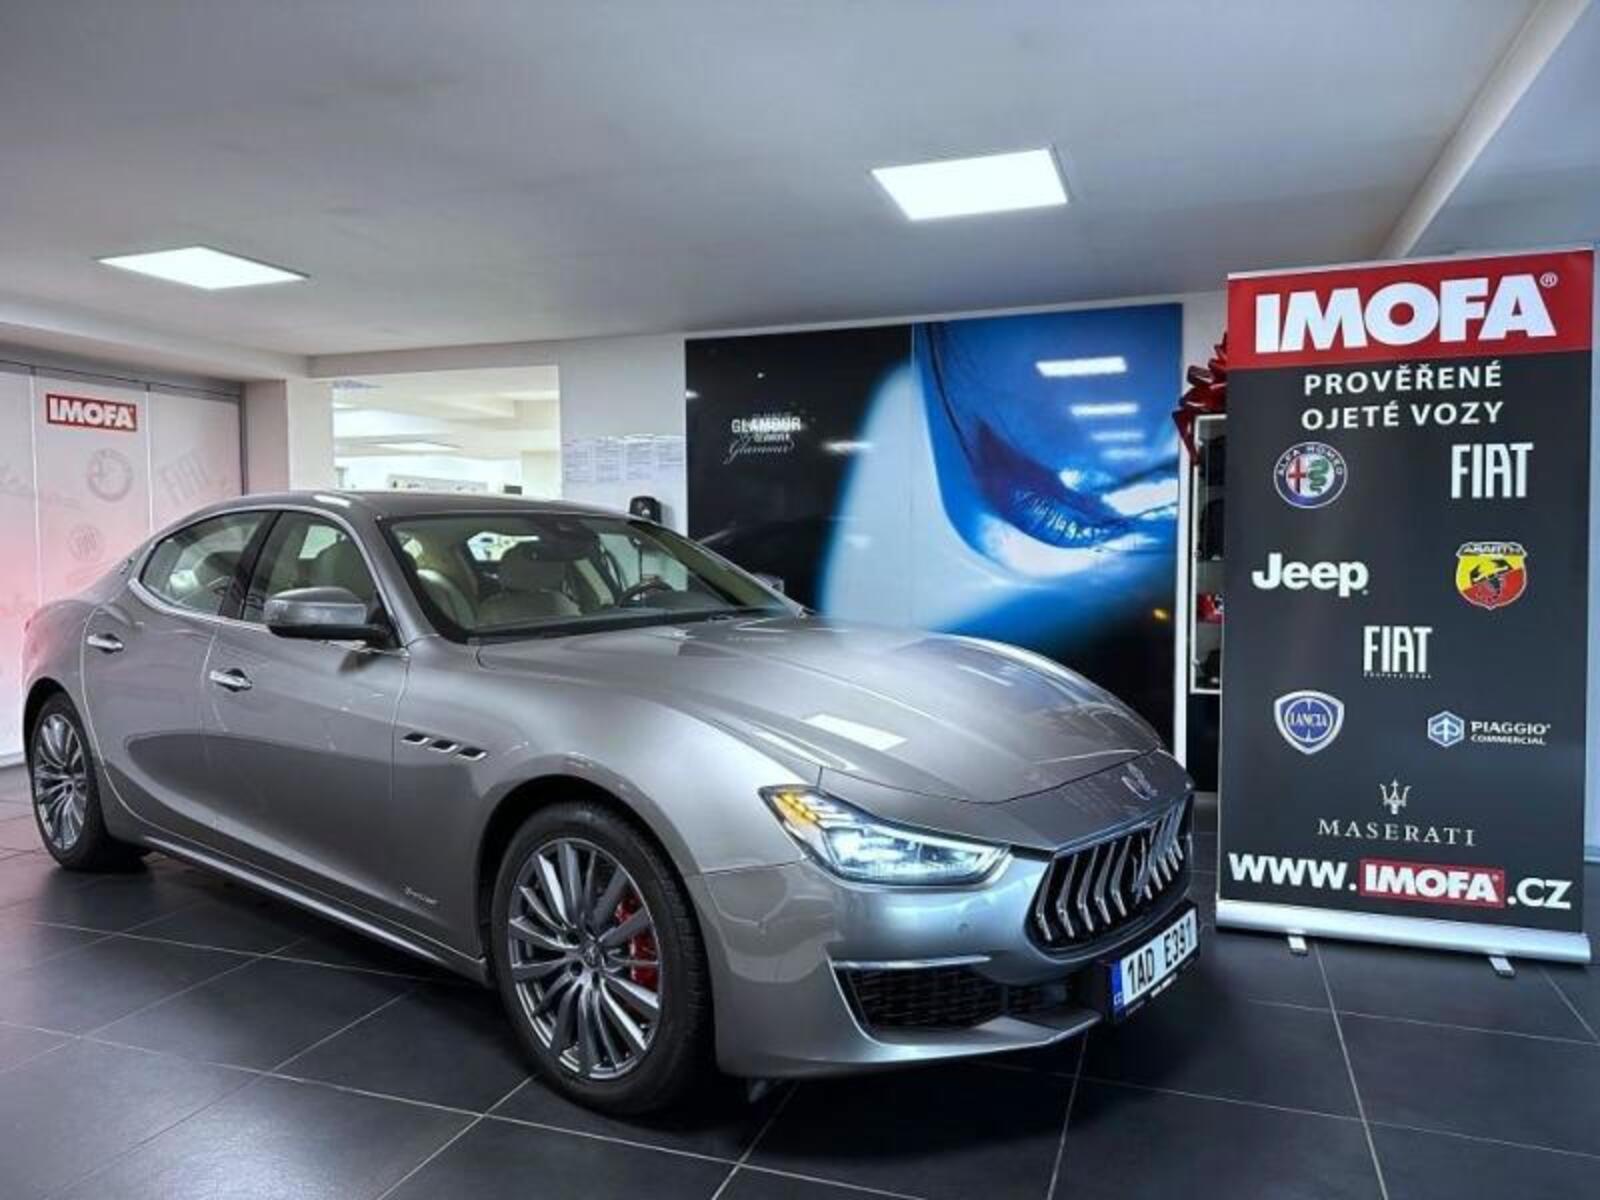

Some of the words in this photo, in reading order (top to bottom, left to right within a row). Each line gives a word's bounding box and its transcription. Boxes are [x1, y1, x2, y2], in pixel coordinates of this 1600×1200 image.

[1255, 274, 1557, 354] IMOFA
[1304, 360, 1503, 396] PROVĚŘENÉ
[50, 397, 134, 429] IMOFA
[1301, 401, 1400, 430] OJETÉ
[1411, 402, 1504, 426] VOZY
[1451, 443, 1534, 499] FIAT
[1252, 552, 1369, 597] Jeep
[1363, 625, 1433, 673] FIAT
[1470, 720, 1547, 735] PIAGGIO
[1317, 818, 1476, 847] MASERATI
